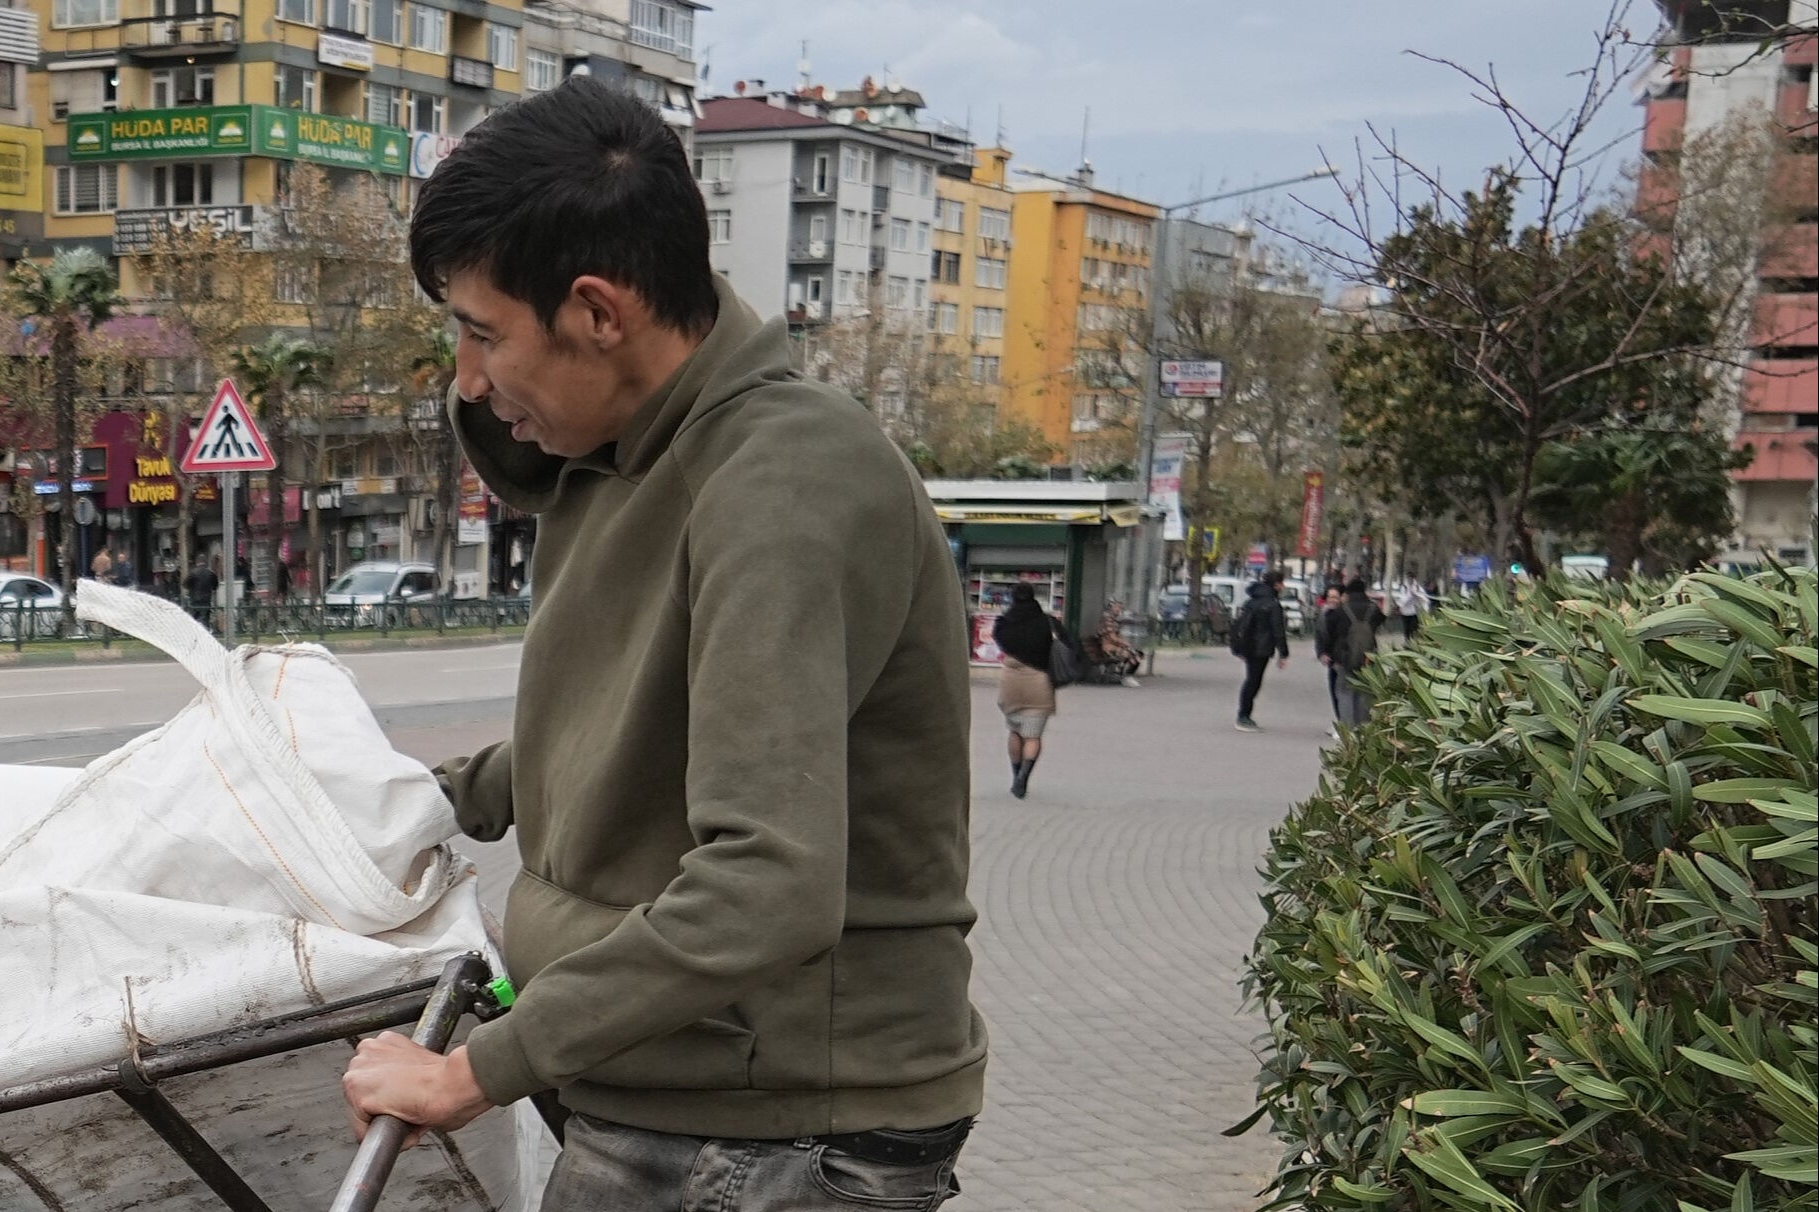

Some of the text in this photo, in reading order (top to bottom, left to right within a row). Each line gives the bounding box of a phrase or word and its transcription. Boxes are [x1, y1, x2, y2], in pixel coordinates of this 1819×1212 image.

[111, 116, 208, 139] HÜDA PAR
[298, 115, 374, 150] HÜDA PAR
[168, 207, 251, 239] YEŞİL
[136, 456, 172, 478] Tavuk
[129, 482, 176, 506] Dünyası
